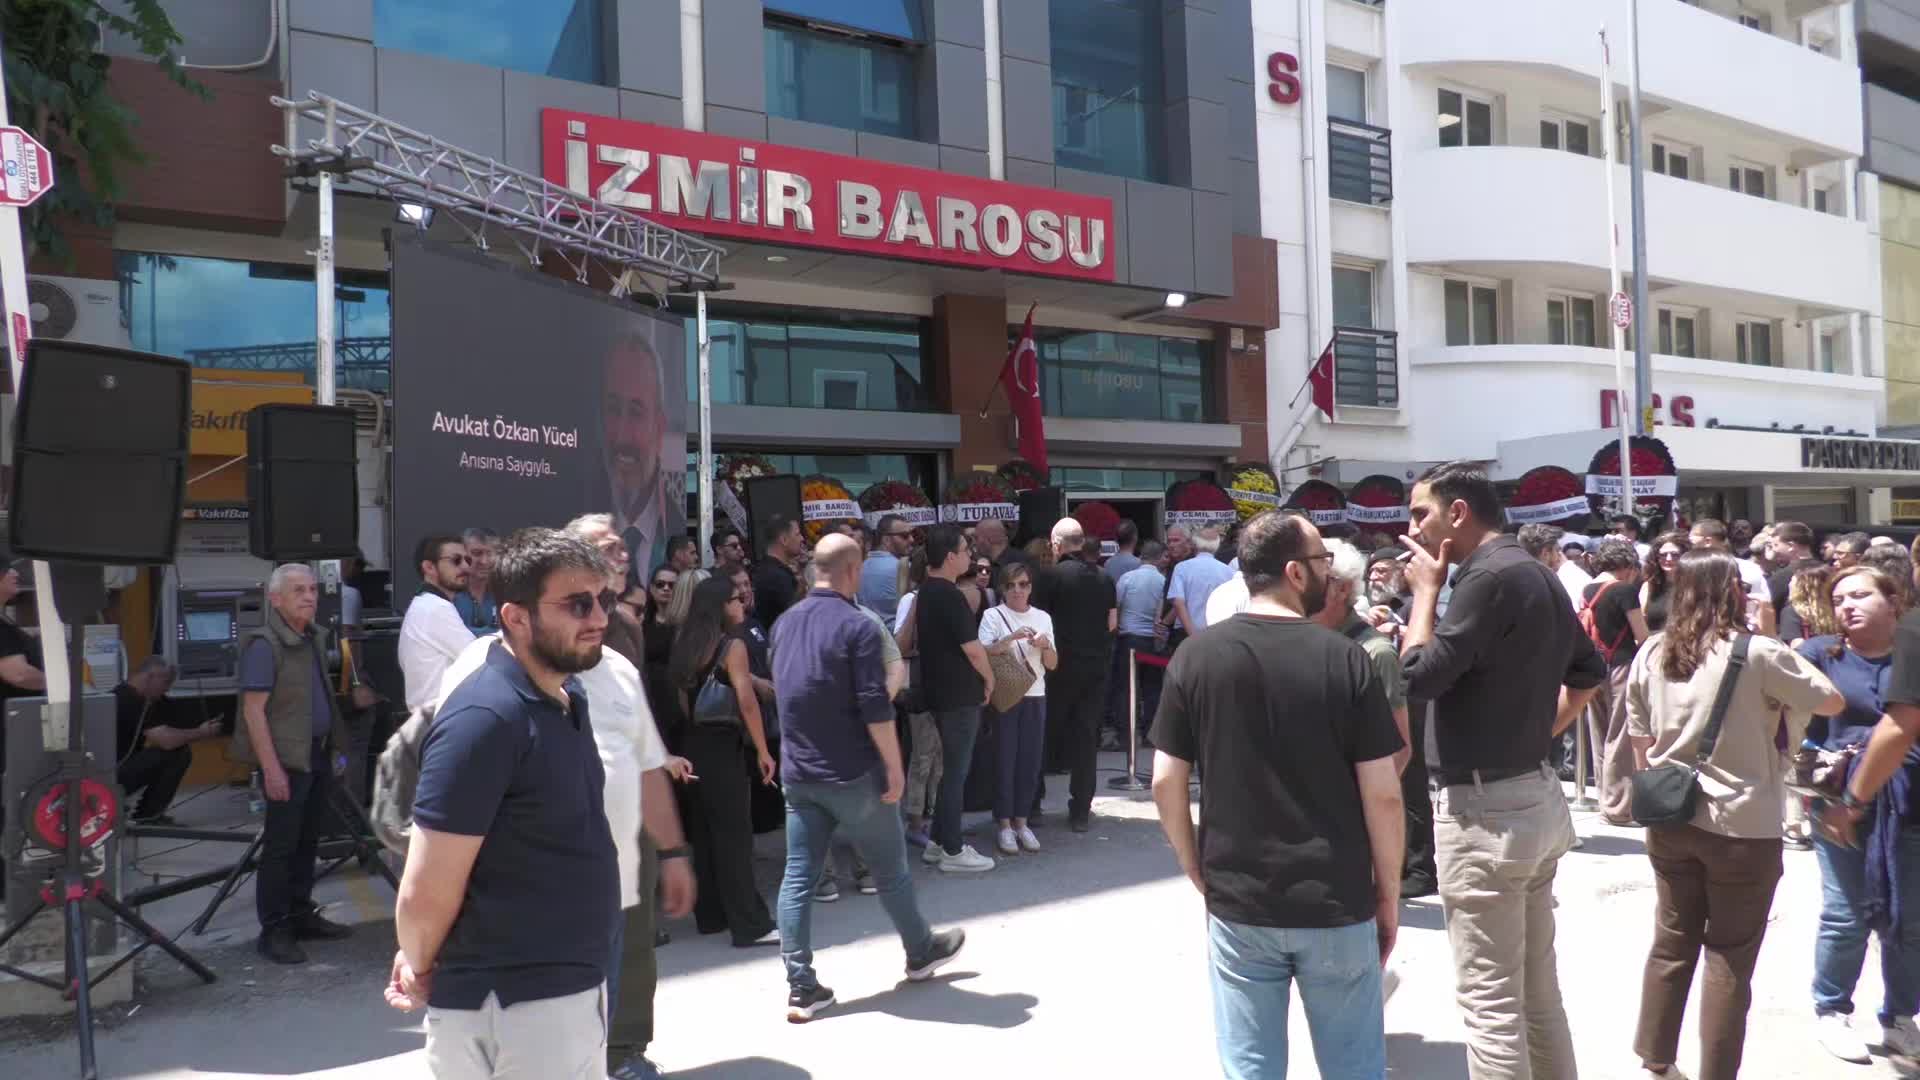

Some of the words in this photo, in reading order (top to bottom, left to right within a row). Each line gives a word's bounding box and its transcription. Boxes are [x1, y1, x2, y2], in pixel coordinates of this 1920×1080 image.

[566, 120, 815, 232] İZMİR
[836, 179, 1105, 269] BAROSU
[432, 411, 491, 437] Avukat
[493, 414, 540, 443] Özkan
[542, 424, 578, 448] Yücel
[459, 451, 505, 471] Anısına
